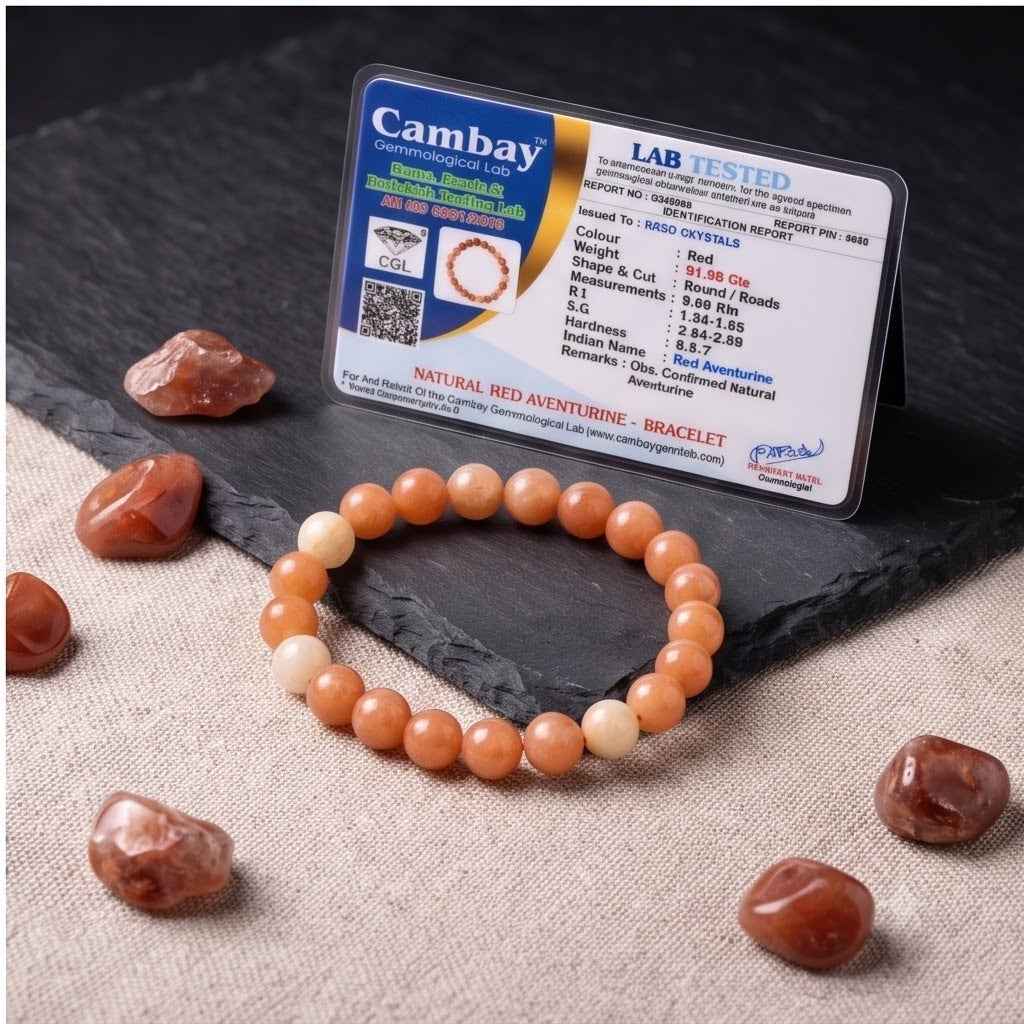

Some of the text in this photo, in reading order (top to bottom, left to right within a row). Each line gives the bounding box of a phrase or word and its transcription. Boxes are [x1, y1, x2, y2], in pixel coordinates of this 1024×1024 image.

[371, 106, 543, 173] Cambay
[374, 139, 511, 177] Gemmological Lab
[598, 155, 609, 166] To
[631, 142, 682, 169] LAB
[690, 155, 791, 191] TESTED
[583, 179, 625, 196] REPORT
[627, 189, 643, 199] NO
[773, 219, 817, 235] REPORT
[818, 228, 838, 240] PIN
[620, 214, 634, 226] To
[663, 207, 794, 242] IDENTIFICATION REPORT
[378, 255, 411, 273] CGL
[573, 239, 620, 261] Weight
[575, 225, 714, 266] Colour Red
[570, 270, 666, 302] Measurements
[571, 255, 780, 311] Shape & Cut Round Roads
[565, 315, 627, 338] Hardness
[567, 300, 590, 315] S.G
[561, 344, 776, 401] Remarks Obs. Confirmed Natural
[563, 329, 775, 388] Indian Name Red Aventurine
[342, 369, 360, 381] For
[361, 375, 380, 387] And
[565, 422, 585, 435] Lab
[627, 375, 694, 399] Aventurine
[414, 366, 483, 394] NATURAL
[490, 384, 523, 402] RED
[526, 393, 626, 426] AVENTURINE
[644, 418, 727, 448] BRACELET
